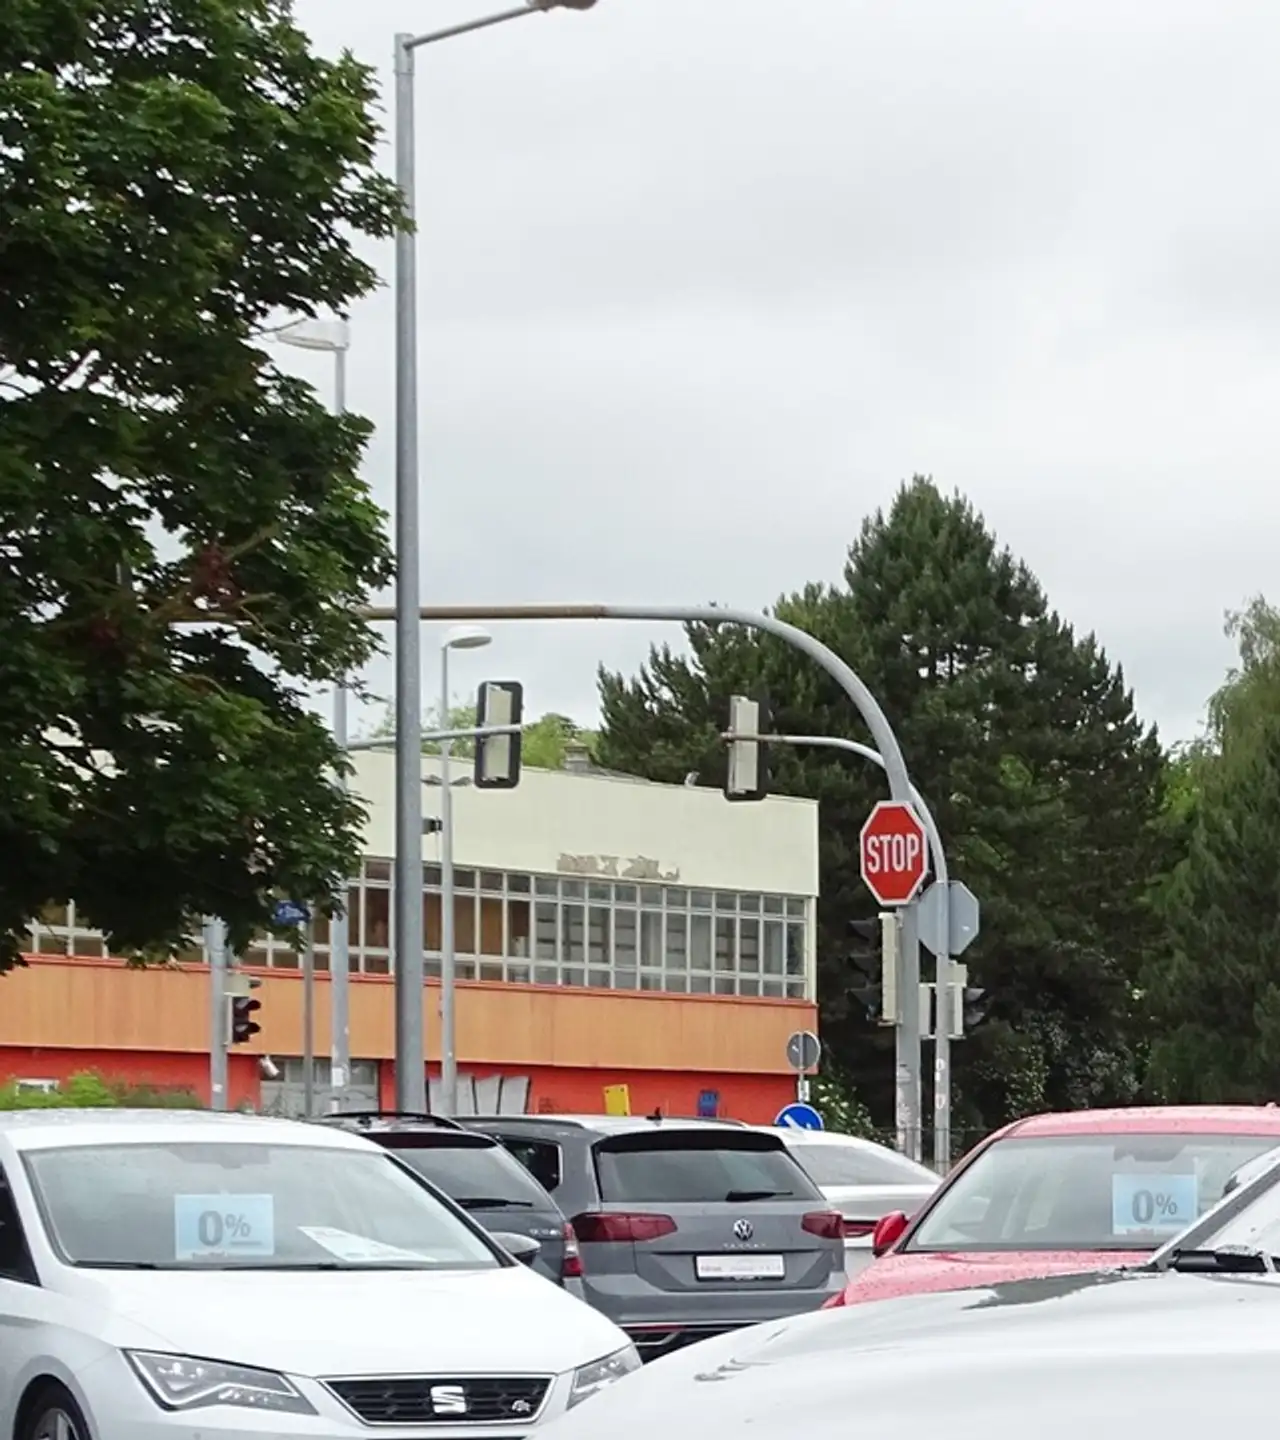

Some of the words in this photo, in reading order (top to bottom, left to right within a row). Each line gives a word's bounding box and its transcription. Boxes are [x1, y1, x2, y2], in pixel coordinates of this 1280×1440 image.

[867, 833, 919, 873] STOP
[1132, 1189, 1178, 1224] 0%
[198, 1210, 251, 1247] 0%
